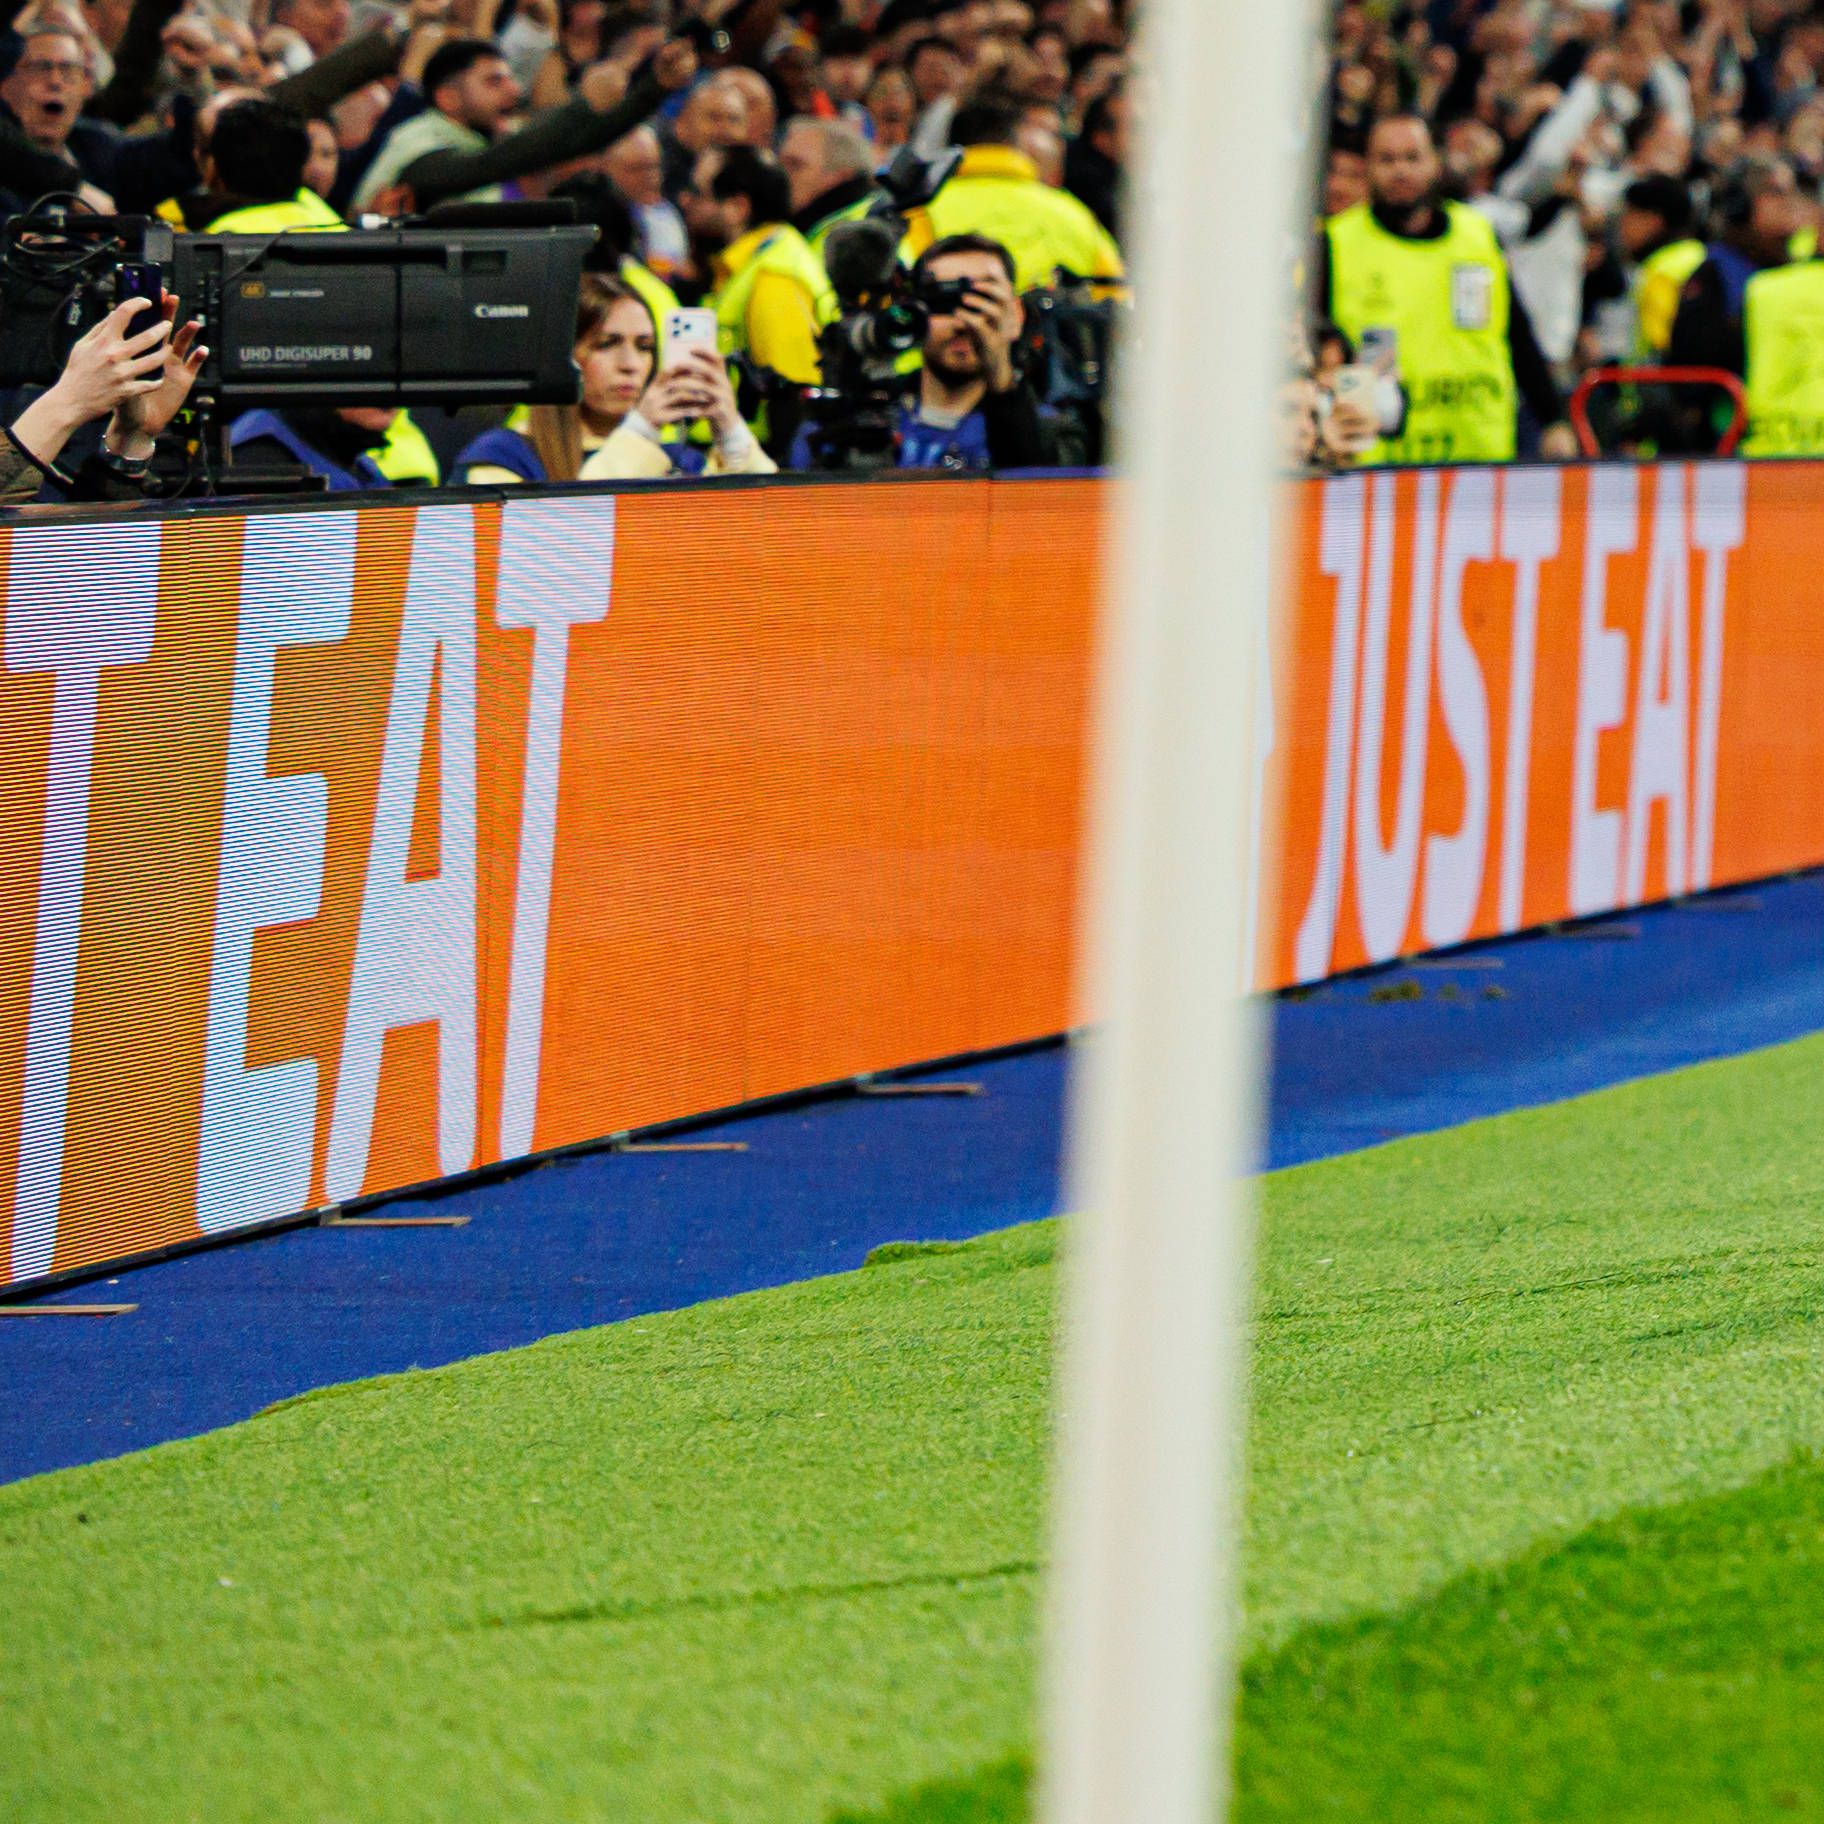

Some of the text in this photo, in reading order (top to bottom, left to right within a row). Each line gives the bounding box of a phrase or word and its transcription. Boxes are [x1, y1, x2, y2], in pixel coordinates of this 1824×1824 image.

[239, 345, 272, 362] UHD
[274, 345, 350, 362] DIGISUPER
[474, 302, 530, 318] Canon
[1295, 462, 1746, 983] JUST EAT
[195, 493, 616, 1236] EAT
